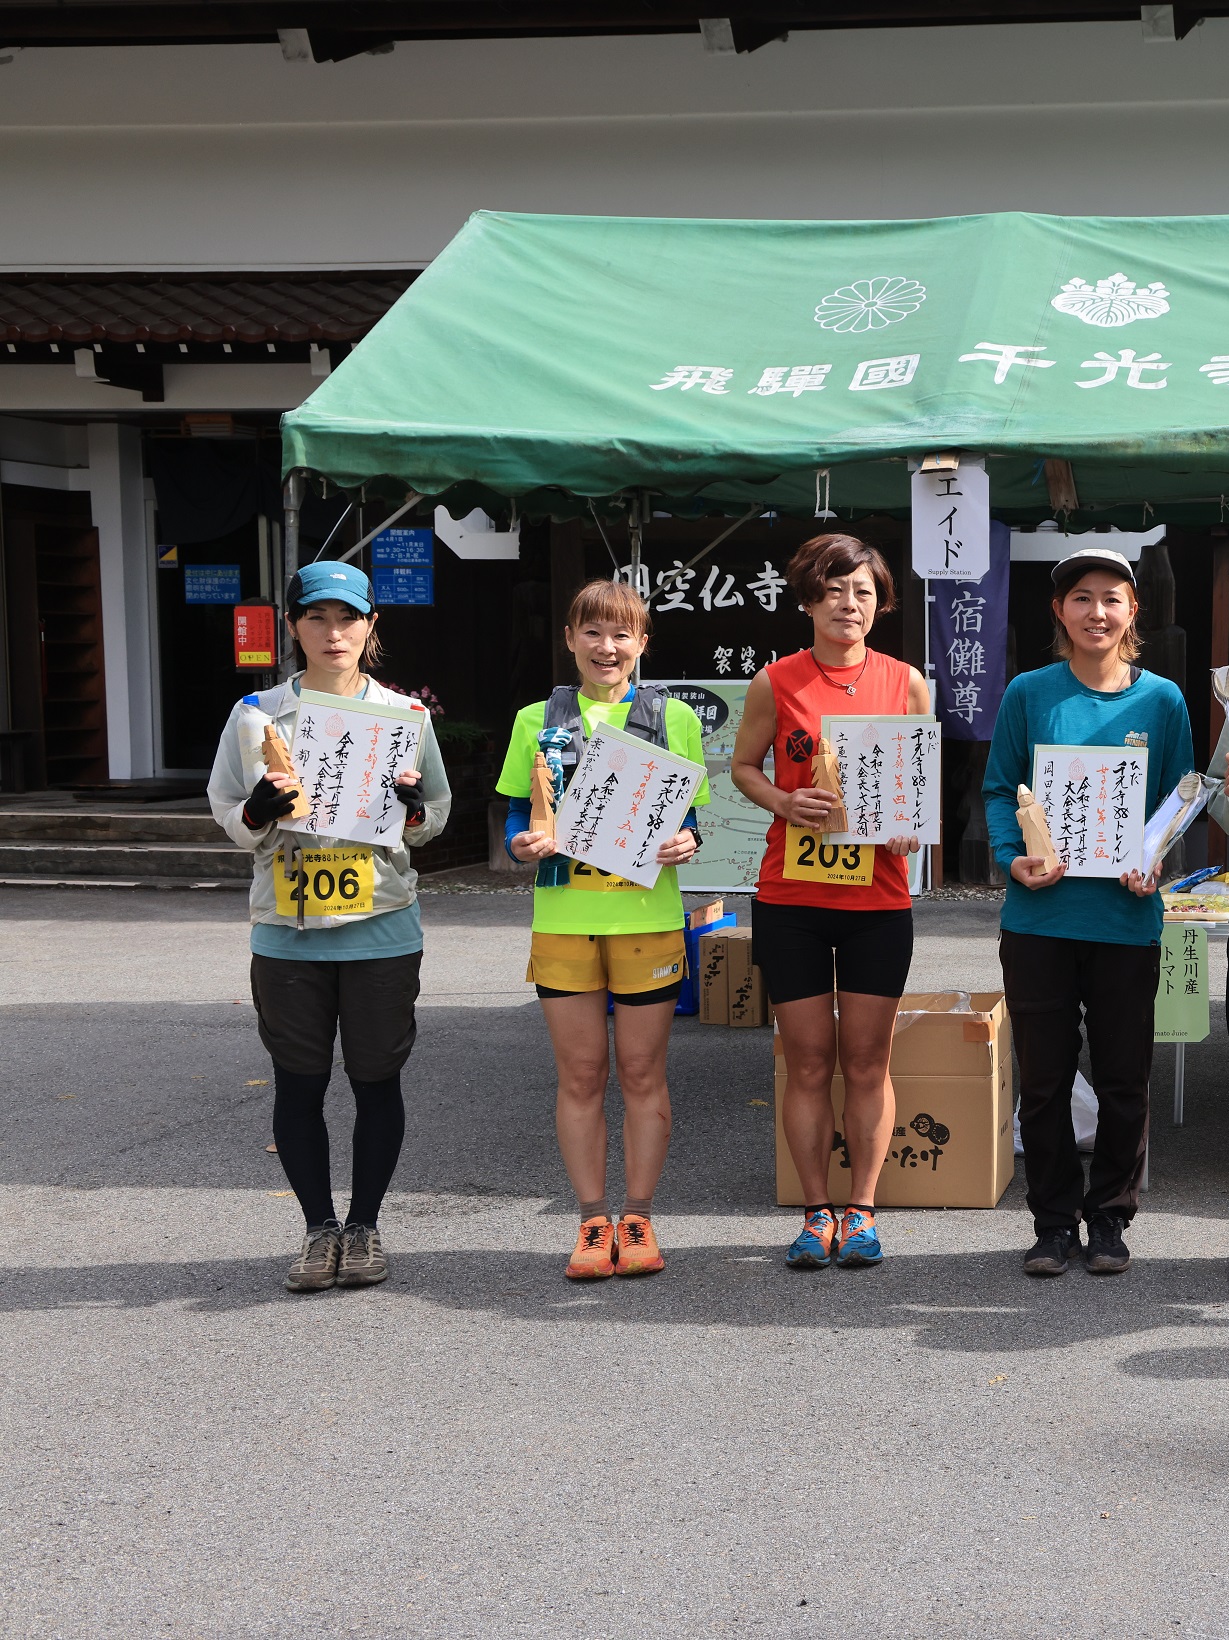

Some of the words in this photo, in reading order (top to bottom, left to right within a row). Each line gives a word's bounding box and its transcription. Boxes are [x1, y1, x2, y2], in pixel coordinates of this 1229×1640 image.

[935, 477, 964, 568] エイド
[928, 568, 948, 576] Supply
[950, 568, 972, 576] Station
[237, 616, 247, 646] 開館中
[240, 654, 270, 662] OPEN
[945, 579, 987, 724] 宿儺尊
[293, 715, 318, 788] 小林都
[927, 730, 939, 753] ひだ
[675, 776, 691, 800] ひだ
[910, 728, 931, 830] 千光寺88トレイル
[1130, 760, 1143, 786] ひだ
[277, 853, 368, 863] 飛光寺88トレイル
[797, 835, 861, 870] 203
[289, 868, 360, 901] 206
[827, 873, 866, 882] 2024年10月27日
[1162, 946, 1176, 995] トマト
[1182, 929, 1199, 995] 丹生川産
